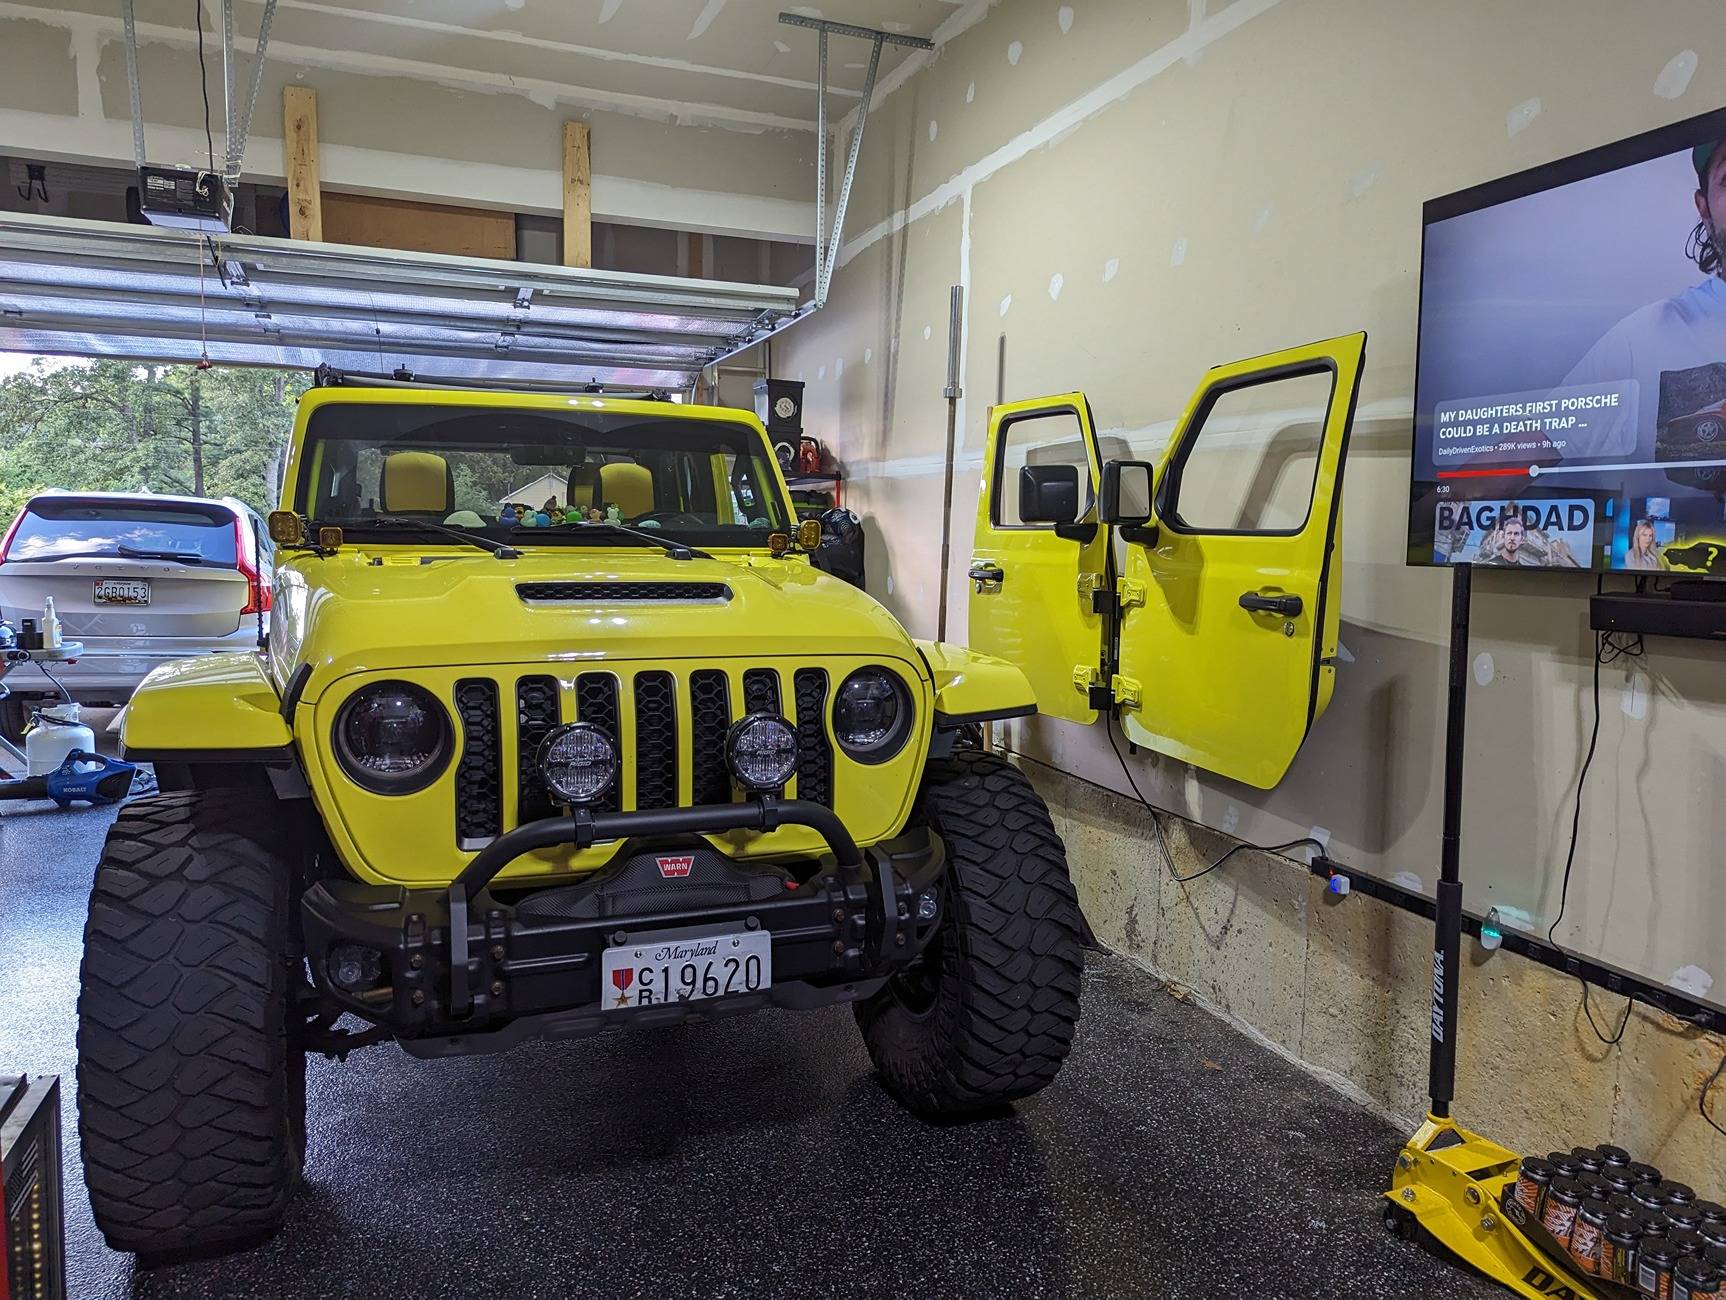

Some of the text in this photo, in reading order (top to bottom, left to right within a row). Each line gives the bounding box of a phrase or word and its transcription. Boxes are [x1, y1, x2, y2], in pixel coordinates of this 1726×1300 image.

[1440, 393, 1619, 423] MY DAUGHTERS FIRST PORSCHE
[1439, 425, 1474, 439] COULD
[1476, 424, 1490, 436] BE
[1492, 422, 1500, 435] A
[1503, 419, 1541, 434] DEATH
[1543, 416, 1576, 430] TRAP
[1517, 441, 1537, 449] views
[1542, 440, 1552, 449] 9h
[1552, 440, 1566, 449] ago
[1436, 485, 1450, 494] 6:30
[1438, 504, 1590, 532] BAGHDAD
[663, 862, 688, 871] WARN
[655, 940, 718, 962] Maryland
[1432, 950, 1445, 1043] DAYTONA
